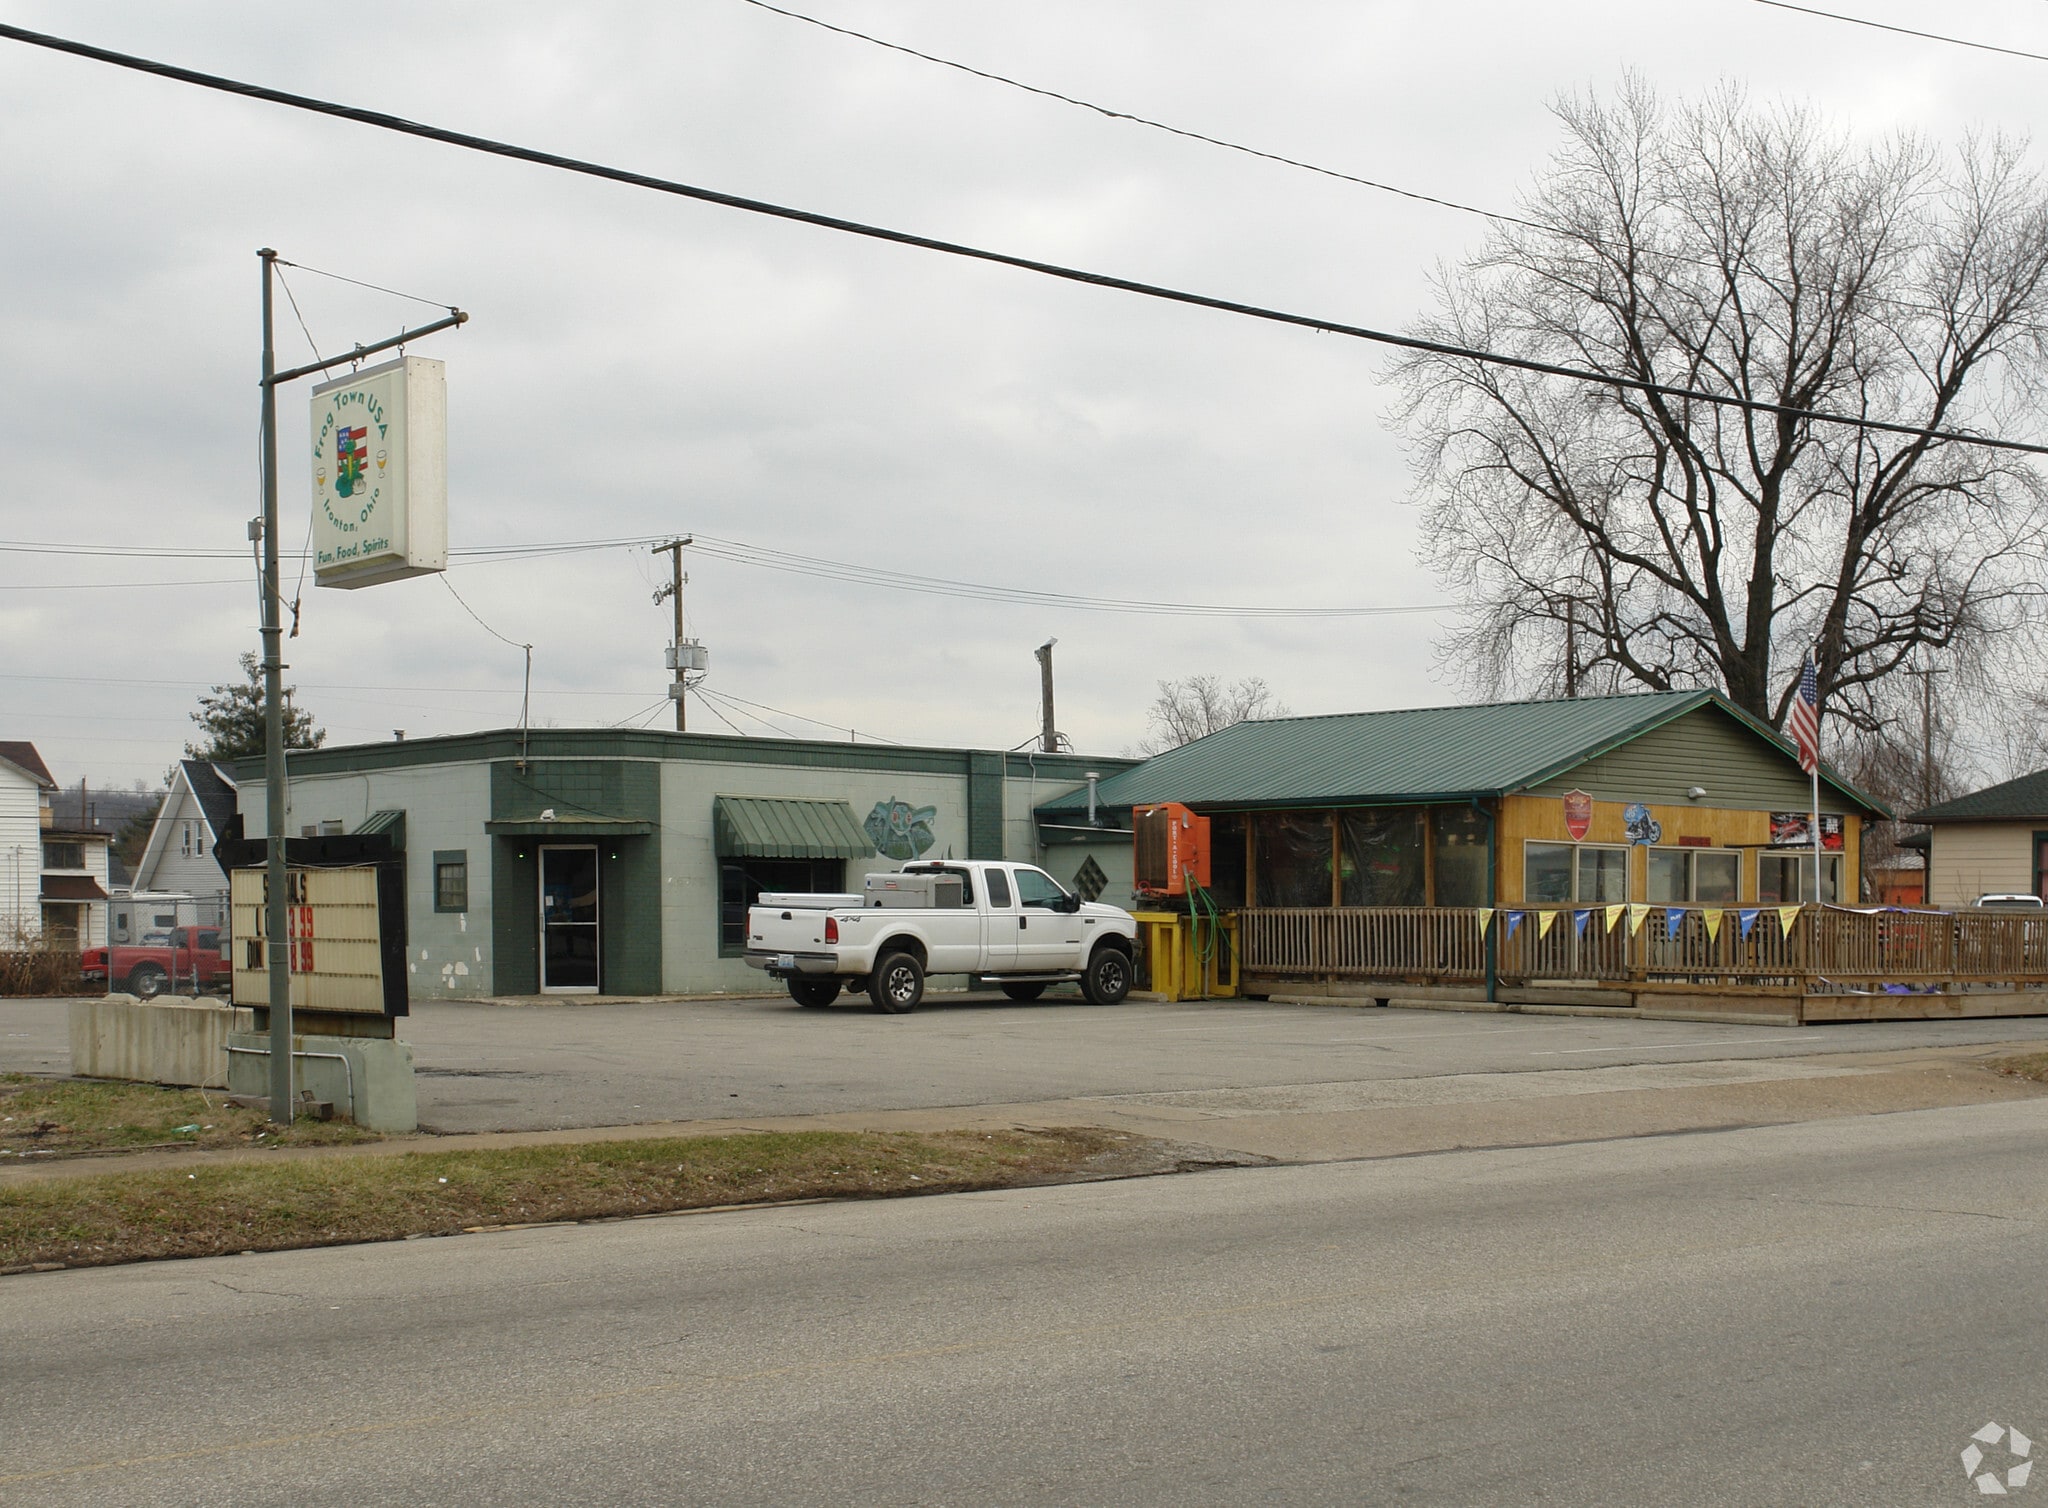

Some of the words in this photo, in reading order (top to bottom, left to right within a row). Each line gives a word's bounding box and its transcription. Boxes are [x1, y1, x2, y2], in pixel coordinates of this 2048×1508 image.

[314, 411, 334, 459] Frog
[333, 390, 365, 410] Town
[367, 393, 389, 441] USA
[360, 487, 380, 523] Ohio
[317, 550, 335, 564] Fun,
[336, 543, 360, 559] Food,
[362, 537, 389, 555] Spirits
